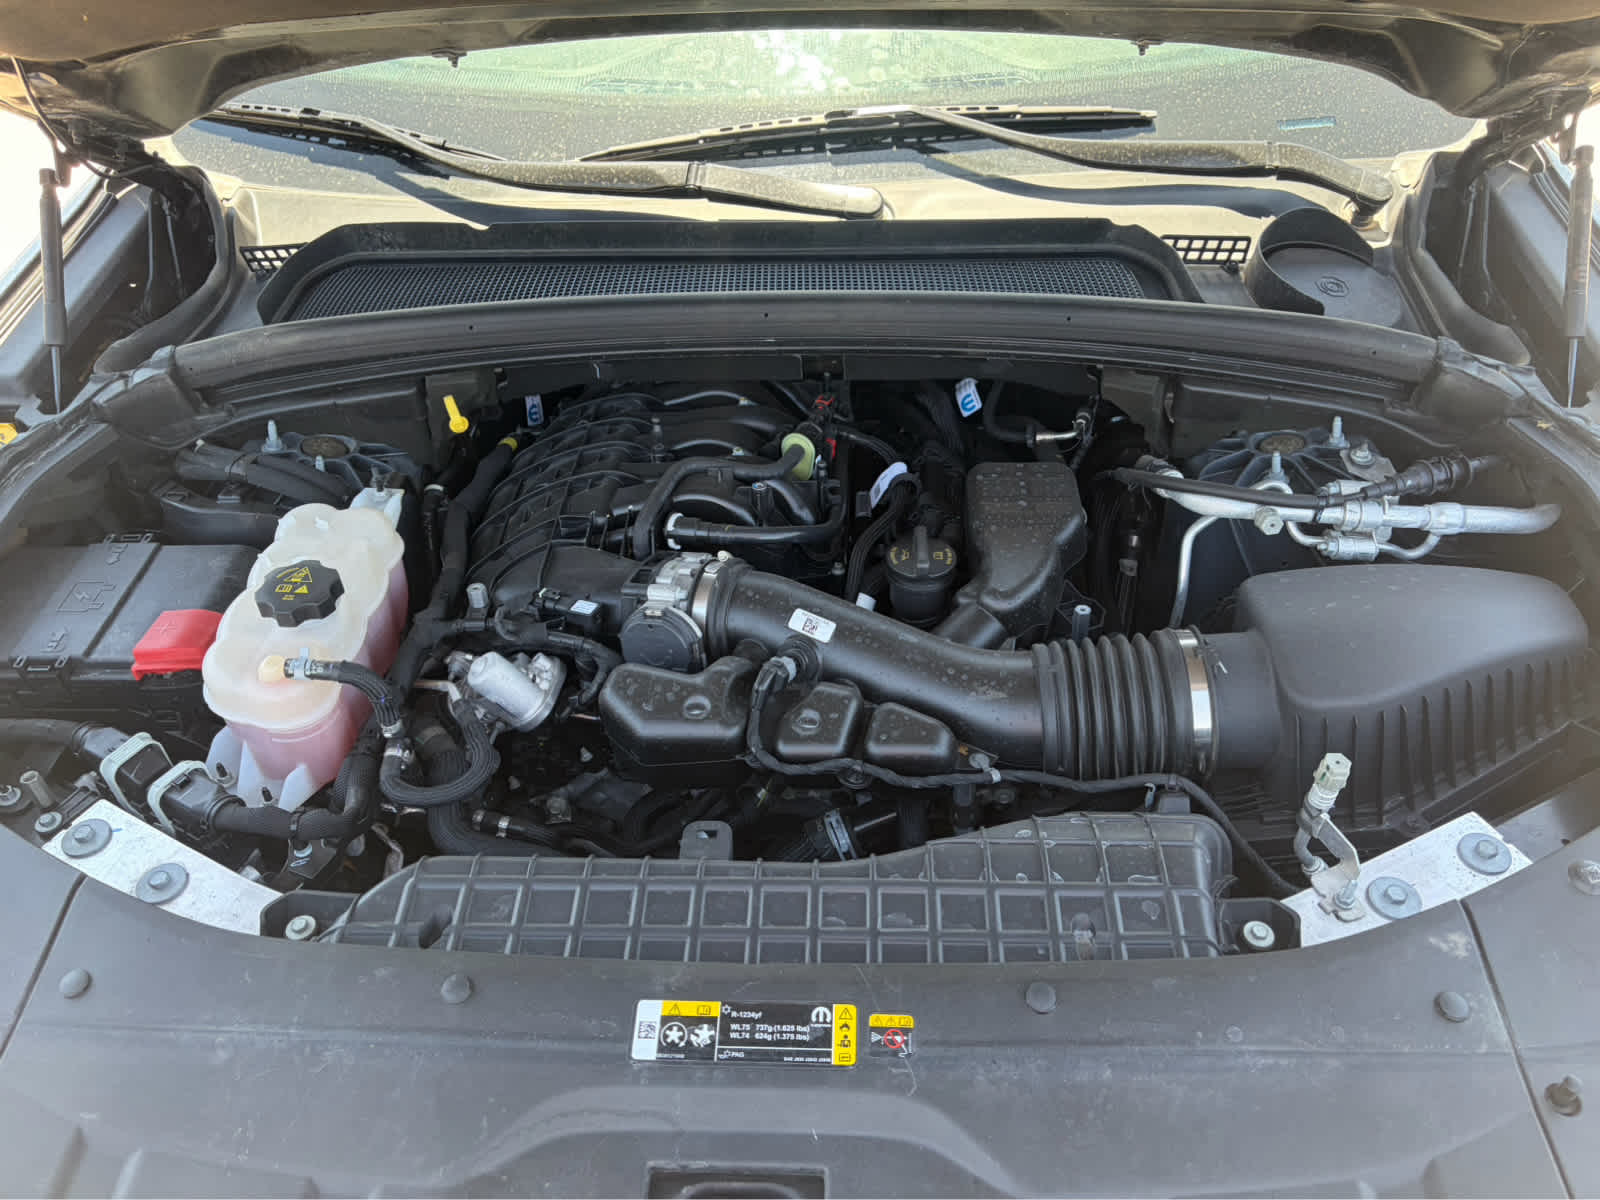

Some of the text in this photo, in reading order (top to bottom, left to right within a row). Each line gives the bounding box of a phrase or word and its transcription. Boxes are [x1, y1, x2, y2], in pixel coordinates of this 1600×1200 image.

[730, 1011, 762, 1020] R-1234yf
[730, 1023, 750, 1031] WL75
[756, 1024, 772, 1033] 737g
[796, 1025, 810, 1033] lbs)
[796, 1033, 810, 1041] lbs)
